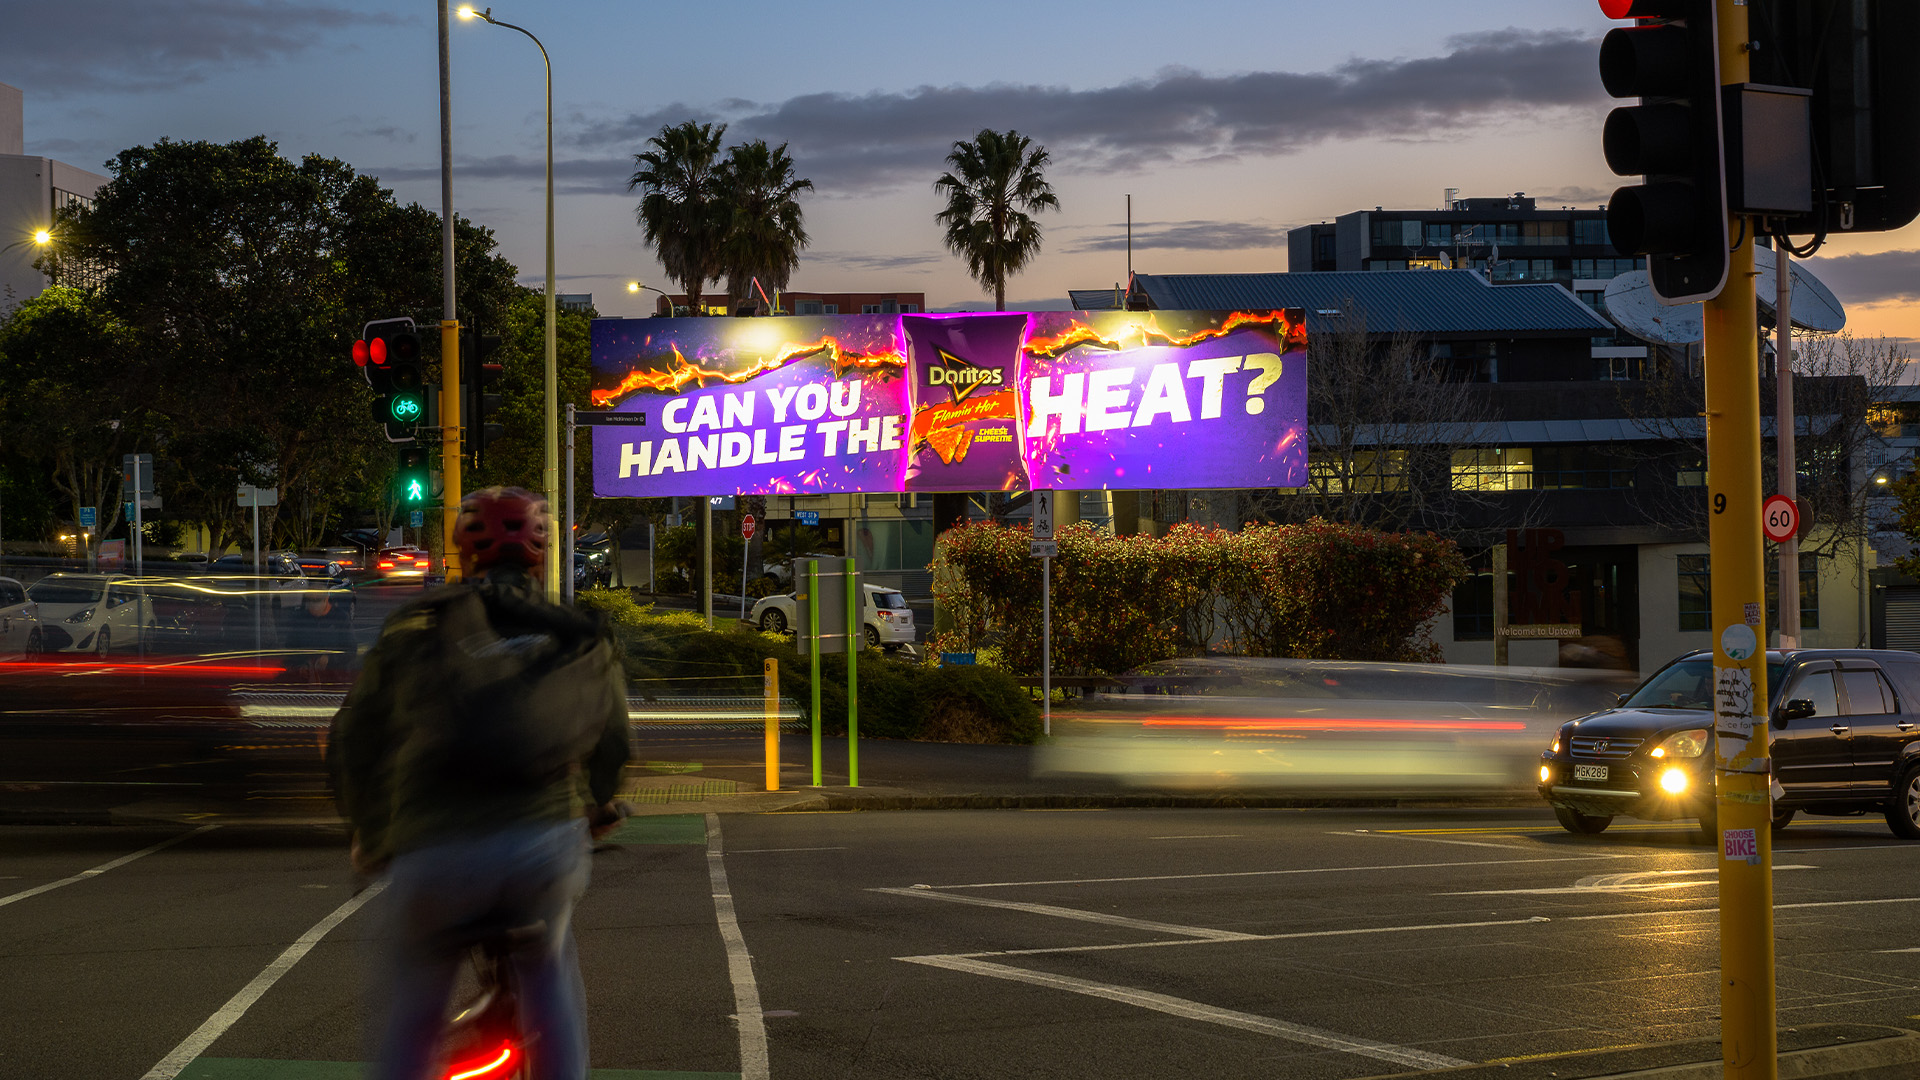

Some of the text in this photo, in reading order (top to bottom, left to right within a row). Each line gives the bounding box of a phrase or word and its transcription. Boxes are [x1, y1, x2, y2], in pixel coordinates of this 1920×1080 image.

[929, 366, 1003, 385] Doritos
[1027, 352, 1283, 438] HEAT?
[662, 379, 862, 434] CAN YOU
[932, 399, 1000, 426] Flamin' Hot
[974, 434, 1012, 443] SUPREME
[979, 427, 1008, 435] CHEESE
[618, 414, 907, 479] HANDLE THE
[1713, 493, 1727, 515] 9
[743, 522, 755, 532] STOP
[1769, 510, 1790, 527] 60
[1496, 626, 1581, 638] Welcome to Uptown
[1724, 829, 1754, 839] CHOOSE
[1724, 839, 1757, 857] BIKE
